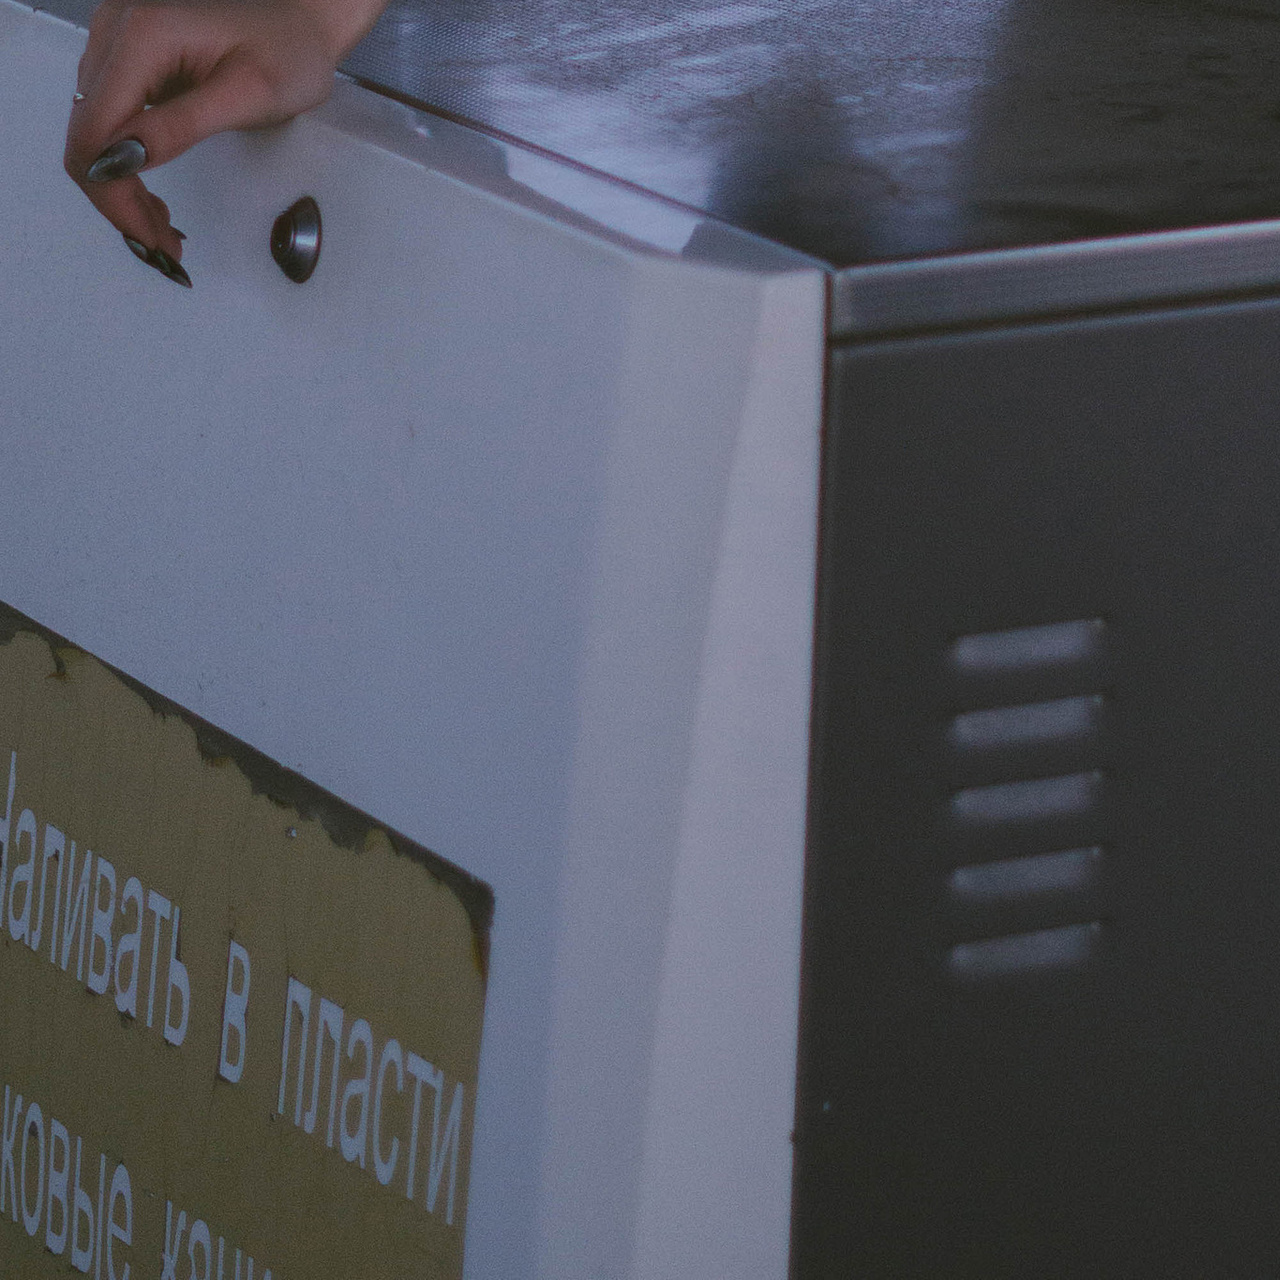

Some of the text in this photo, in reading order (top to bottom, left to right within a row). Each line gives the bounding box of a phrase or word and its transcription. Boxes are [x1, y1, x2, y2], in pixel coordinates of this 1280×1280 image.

[0, 1084, 134, 1280] ковые
[218, 940, 251, 1084] в
[277, 975, 464, 1226] пласти
